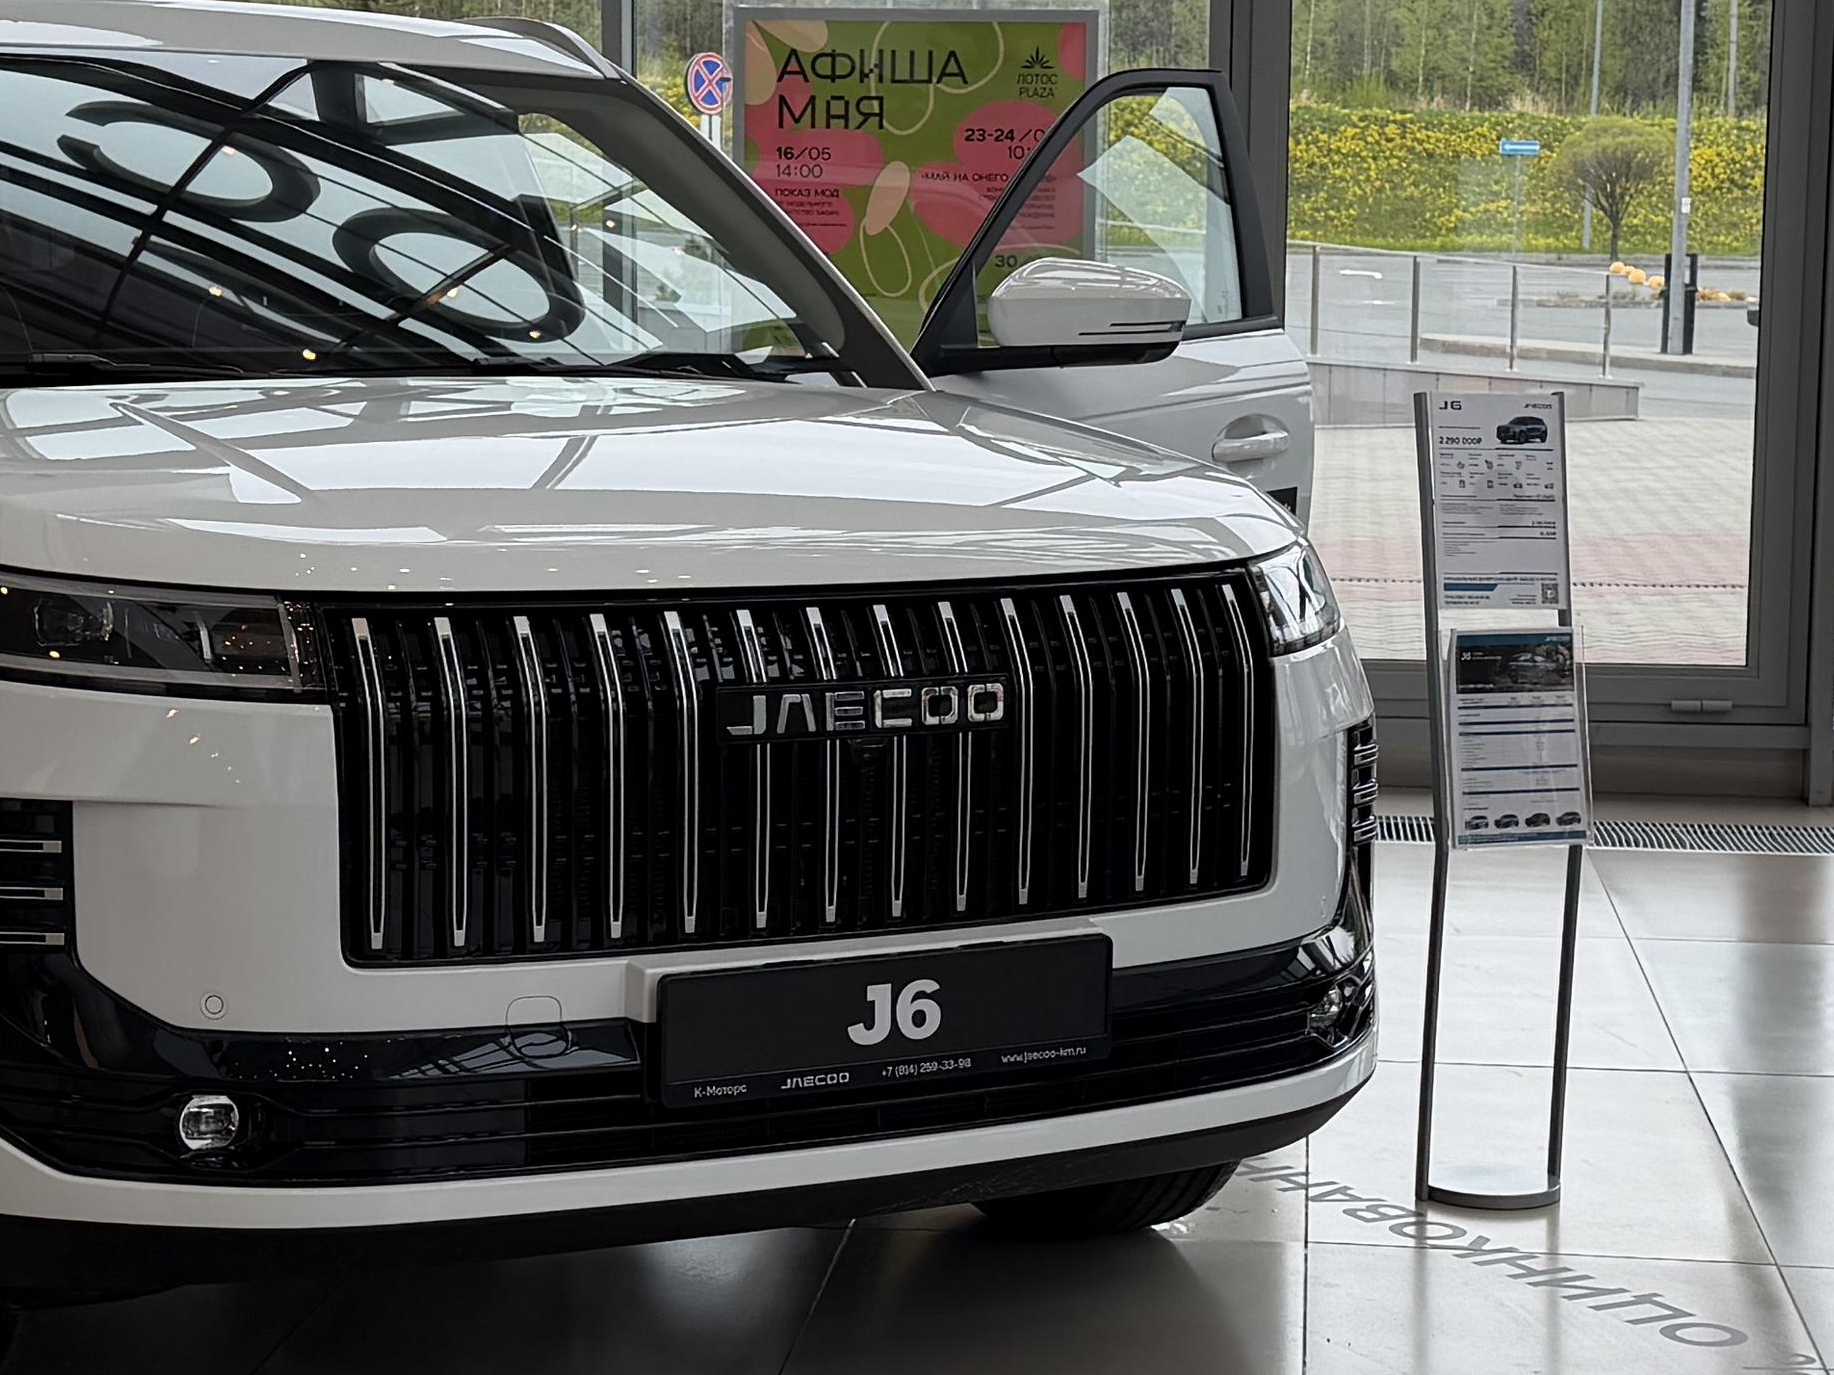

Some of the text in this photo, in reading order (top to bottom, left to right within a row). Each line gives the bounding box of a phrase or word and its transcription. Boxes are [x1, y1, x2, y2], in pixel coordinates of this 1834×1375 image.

[776, 48, 968, 85] АФИША
[1016, 73, 1058, 85] ЛОТОС
[1019, 85, 1055, 98] PLAZA
[777, 95, 885, 130] МАЯ
[964, 128, 1015, 142] 23-24
[776, 146, 832, 161] 16/05
[776, 164, 823, 179] 14:00
[775, 188, 840, 199] ПОКАЗ МОД
[1438, 400, 1462, 411] J6
[725, 682, 1006, 736] JAECOO
[846, 979, 942, 1046] J6
[694, 1084, 747, 1098] К-Моторс
[780, 1072, 850, 1089] JAECOO
[1235, 1156, 1748, 1347] ОЦИНКОВАНН
